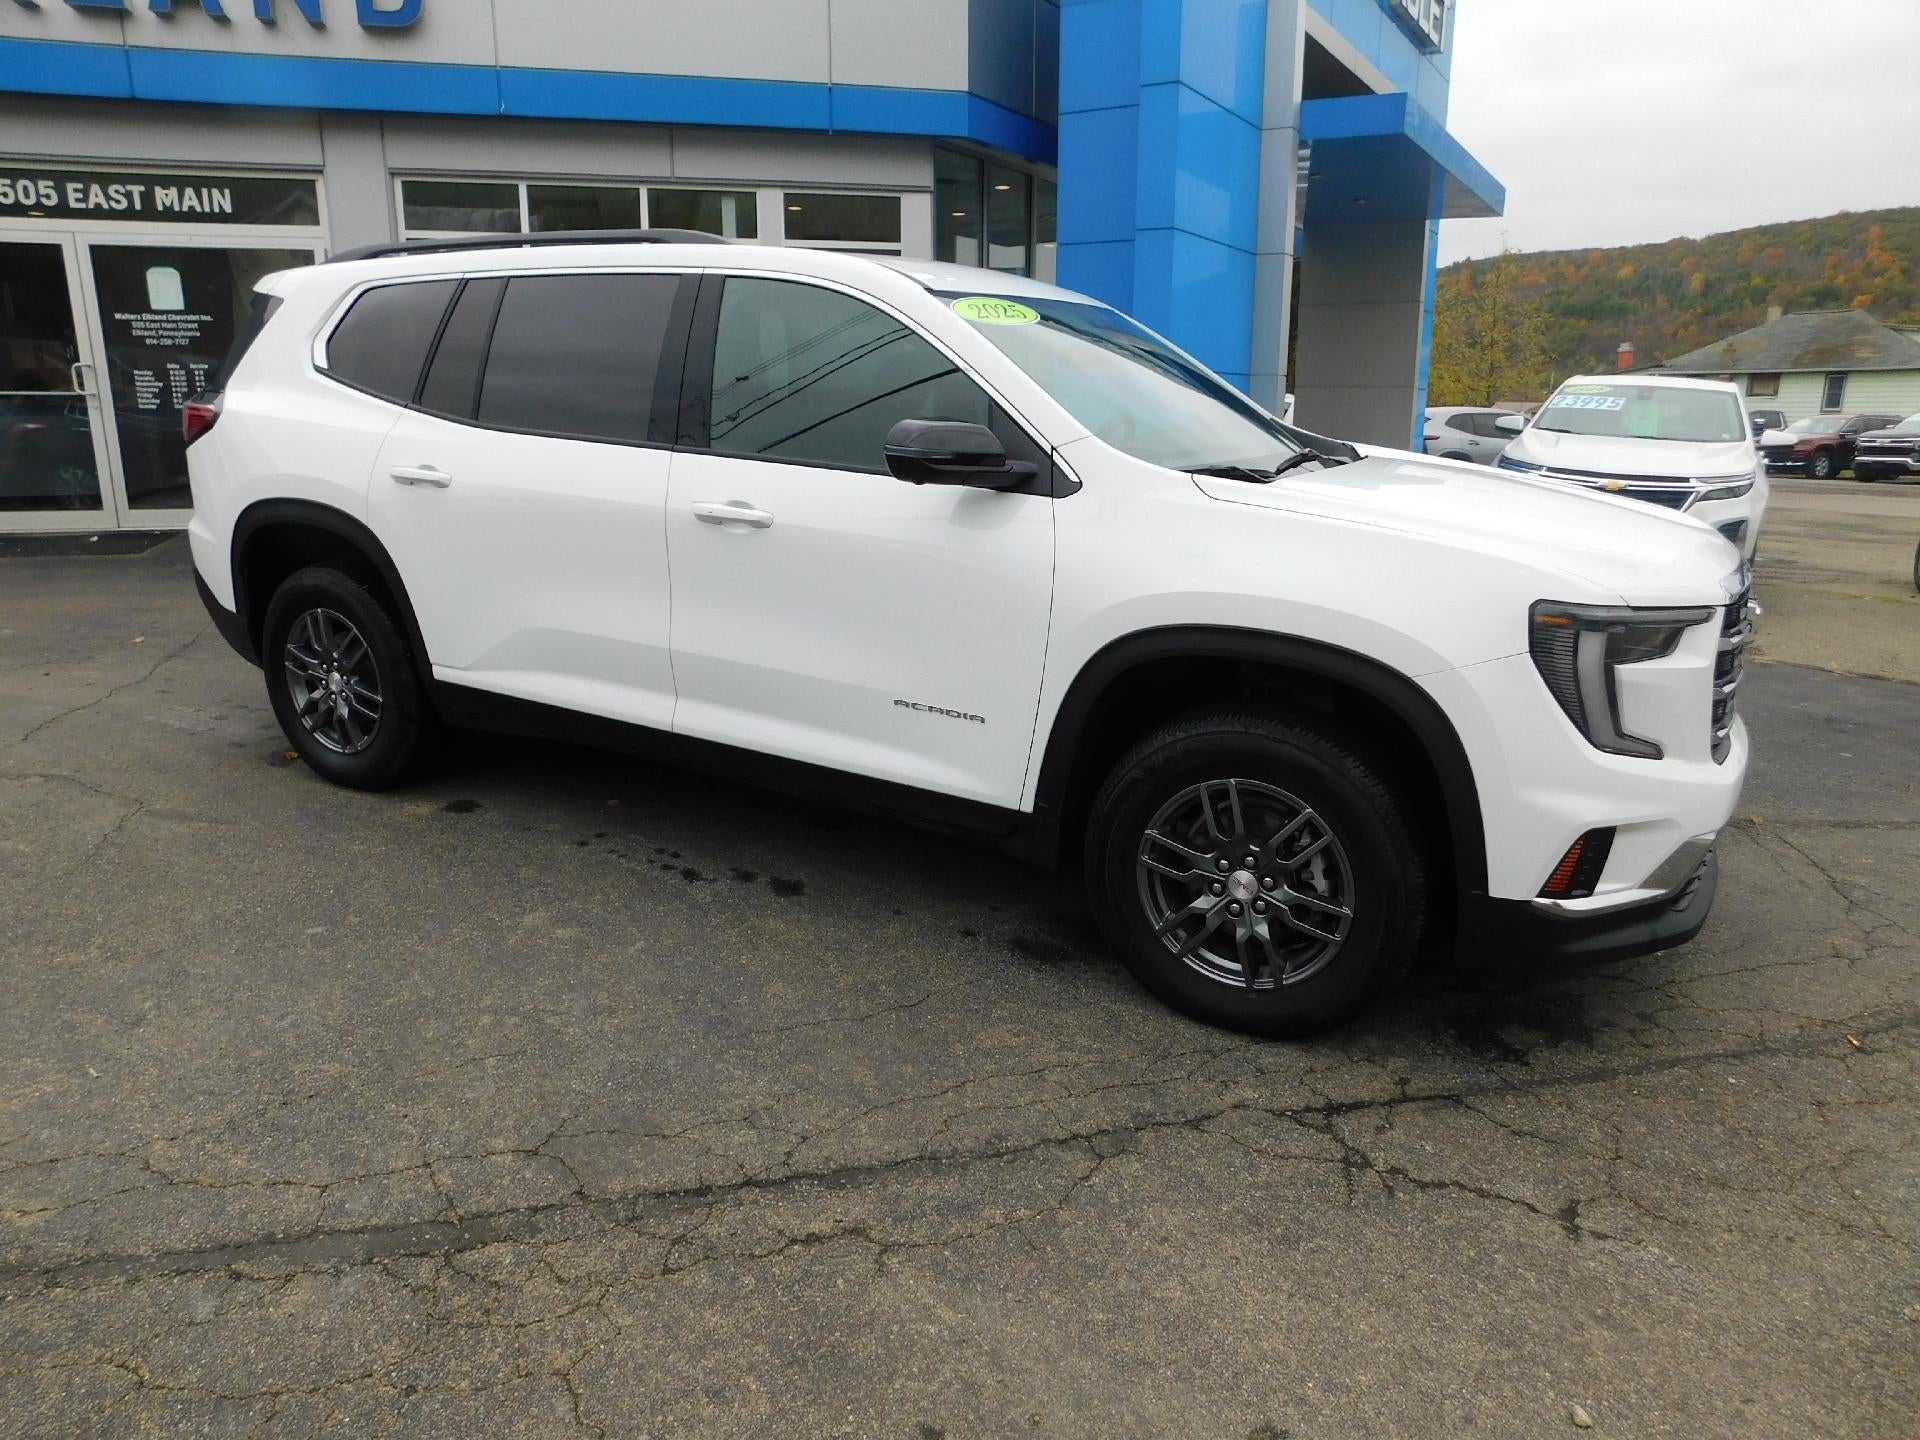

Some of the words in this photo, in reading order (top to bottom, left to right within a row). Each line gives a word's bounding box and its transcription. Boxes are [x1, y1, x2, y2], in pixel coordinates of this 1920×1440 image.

[0, 179, 59, 206] 505
[66, 183, 145, 210] EAST
[155, 186, 232, 213] MAIN
[968, 303, 1027, 319] 2025
[1551, 396, 1621, 409] 23995
[893, 699, 985, 724] ACADIA
